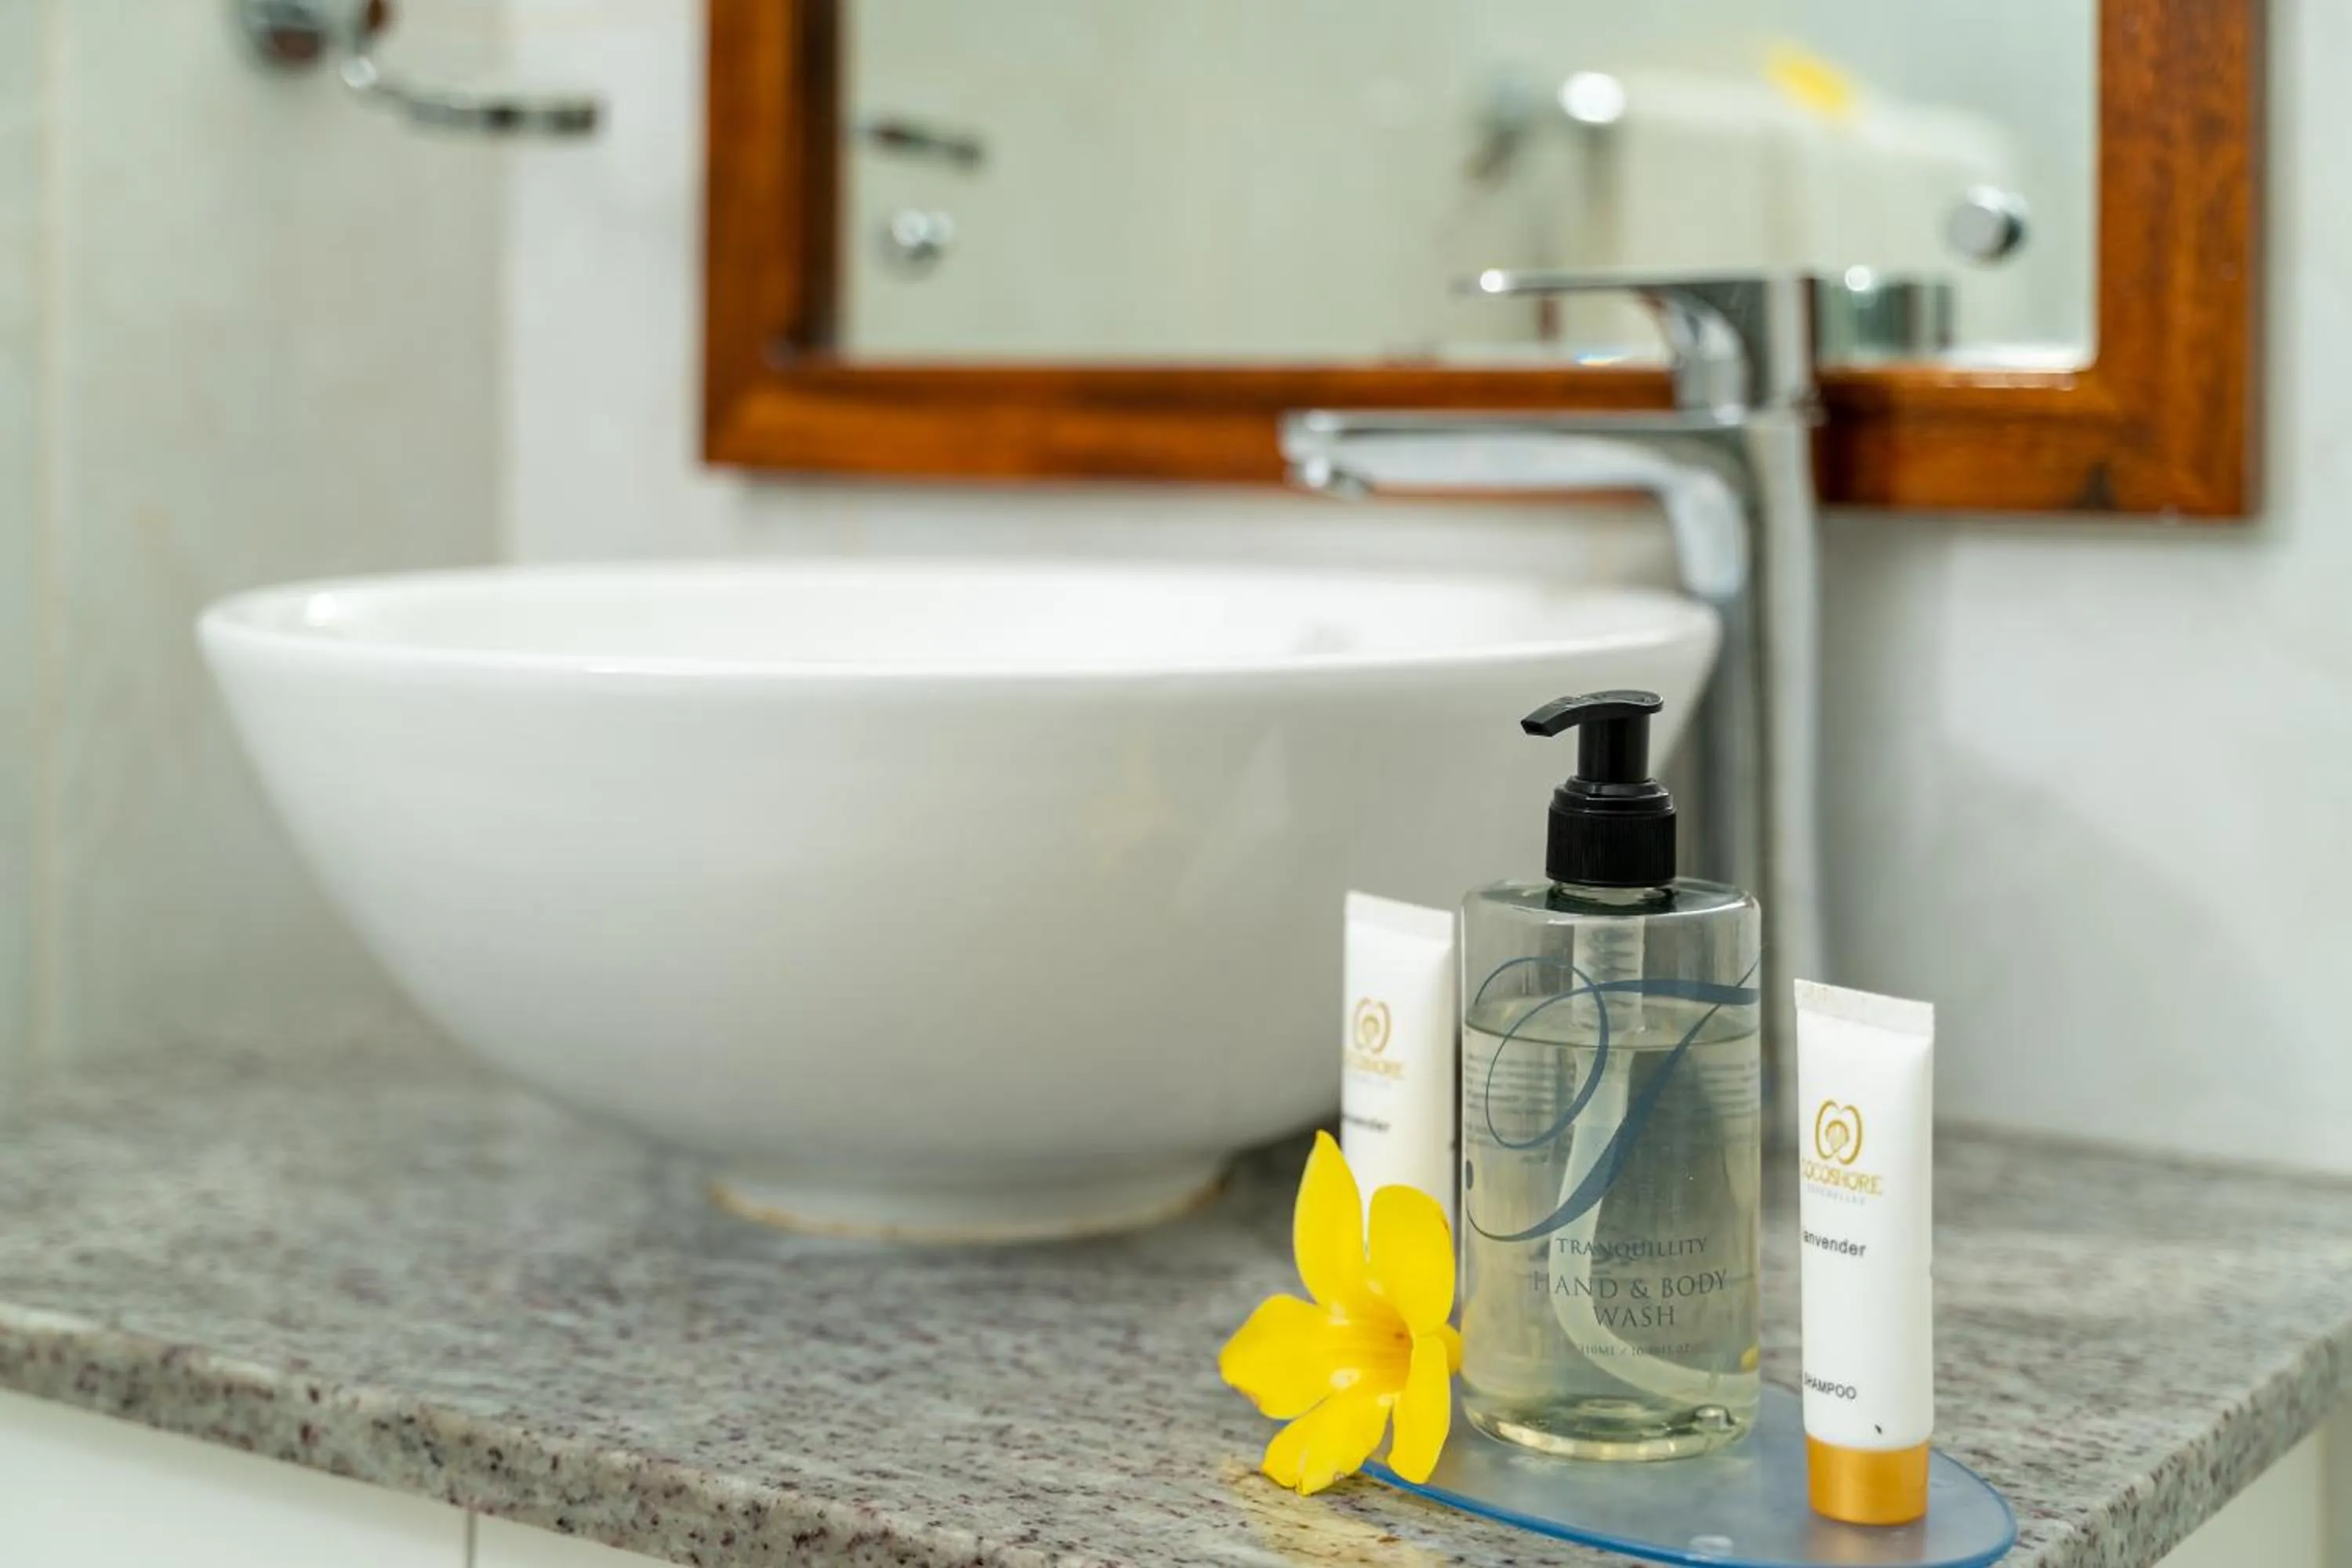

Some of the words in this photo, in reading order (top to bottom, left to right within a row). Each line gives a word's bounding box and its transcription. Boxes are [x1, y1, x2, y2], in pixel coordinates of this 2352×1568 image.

[1555, 1237, 1708, 1260] TRANQUILLITY
[1802, 1228, 1867, 1257] anvender
[1533, 1270, 1619, 1300] HAND
[1629, 1278, 1650, 1300] &
[1661, 1267, 1728, 1299] BODY
[1592, 1305, 1676, 1328] WASH
